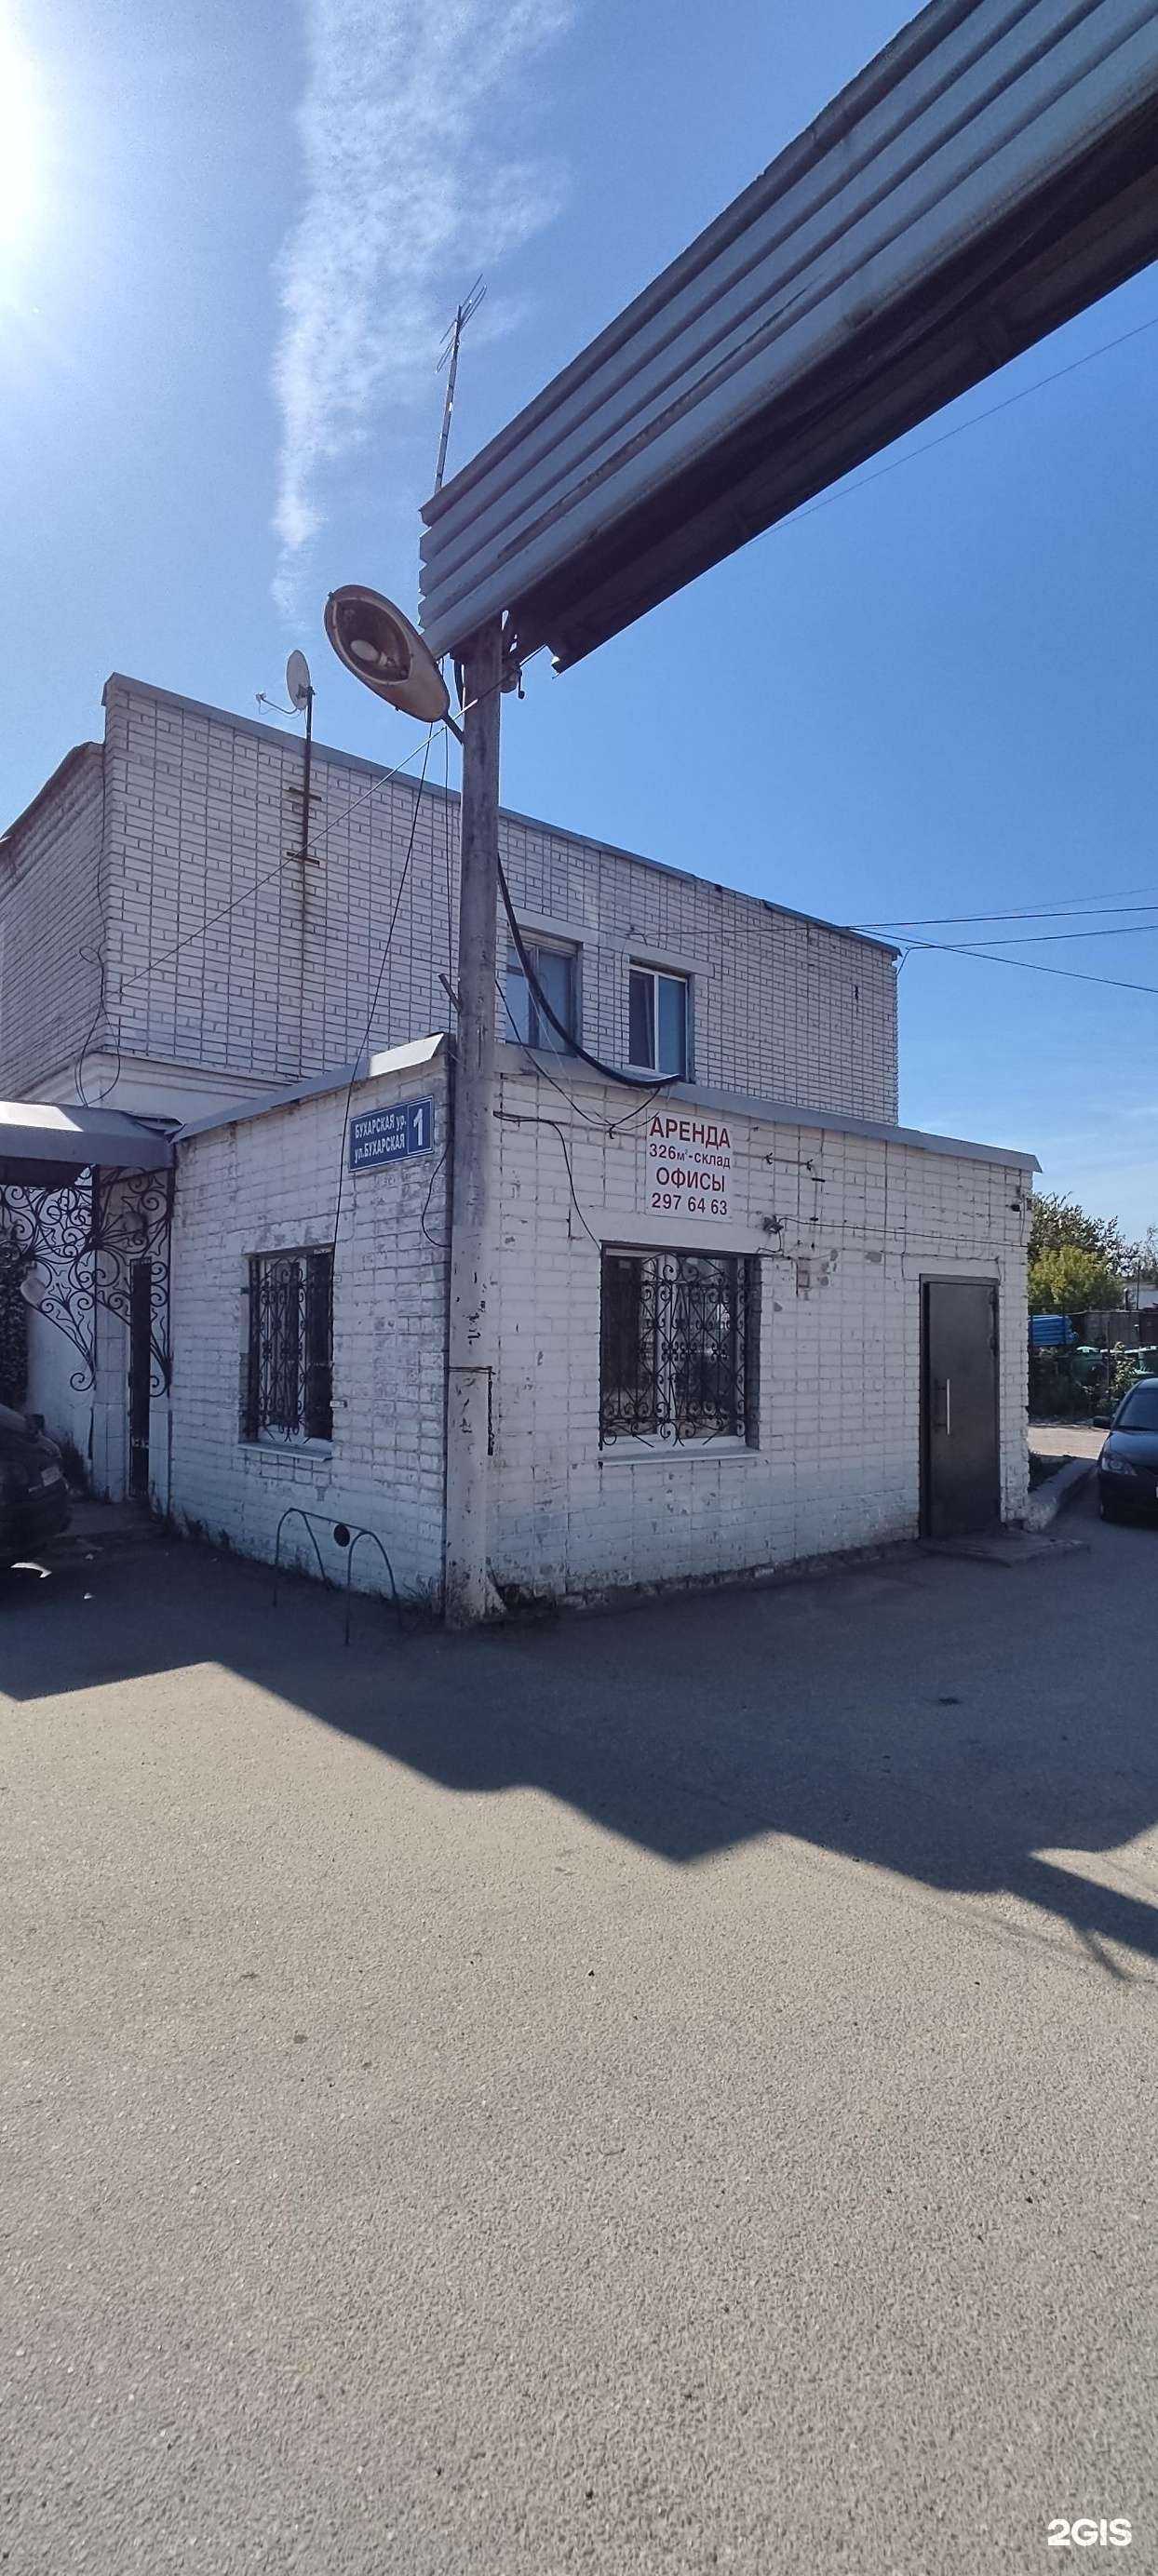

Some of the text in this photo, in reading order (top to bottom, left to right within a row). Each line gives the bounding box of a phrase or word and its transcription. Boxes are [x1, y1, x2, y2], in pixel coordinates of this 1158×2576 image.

[355, 1114, 395, 1139] БУХАРСКАЯ
[413, 1108, 423, 1147] 1
[650, 1117, 731, 1150] АРЕНДА
[656, 1167, 725, 1192] ОФИСЫ
[652, 1192, 728, 1215] 297 64 63
